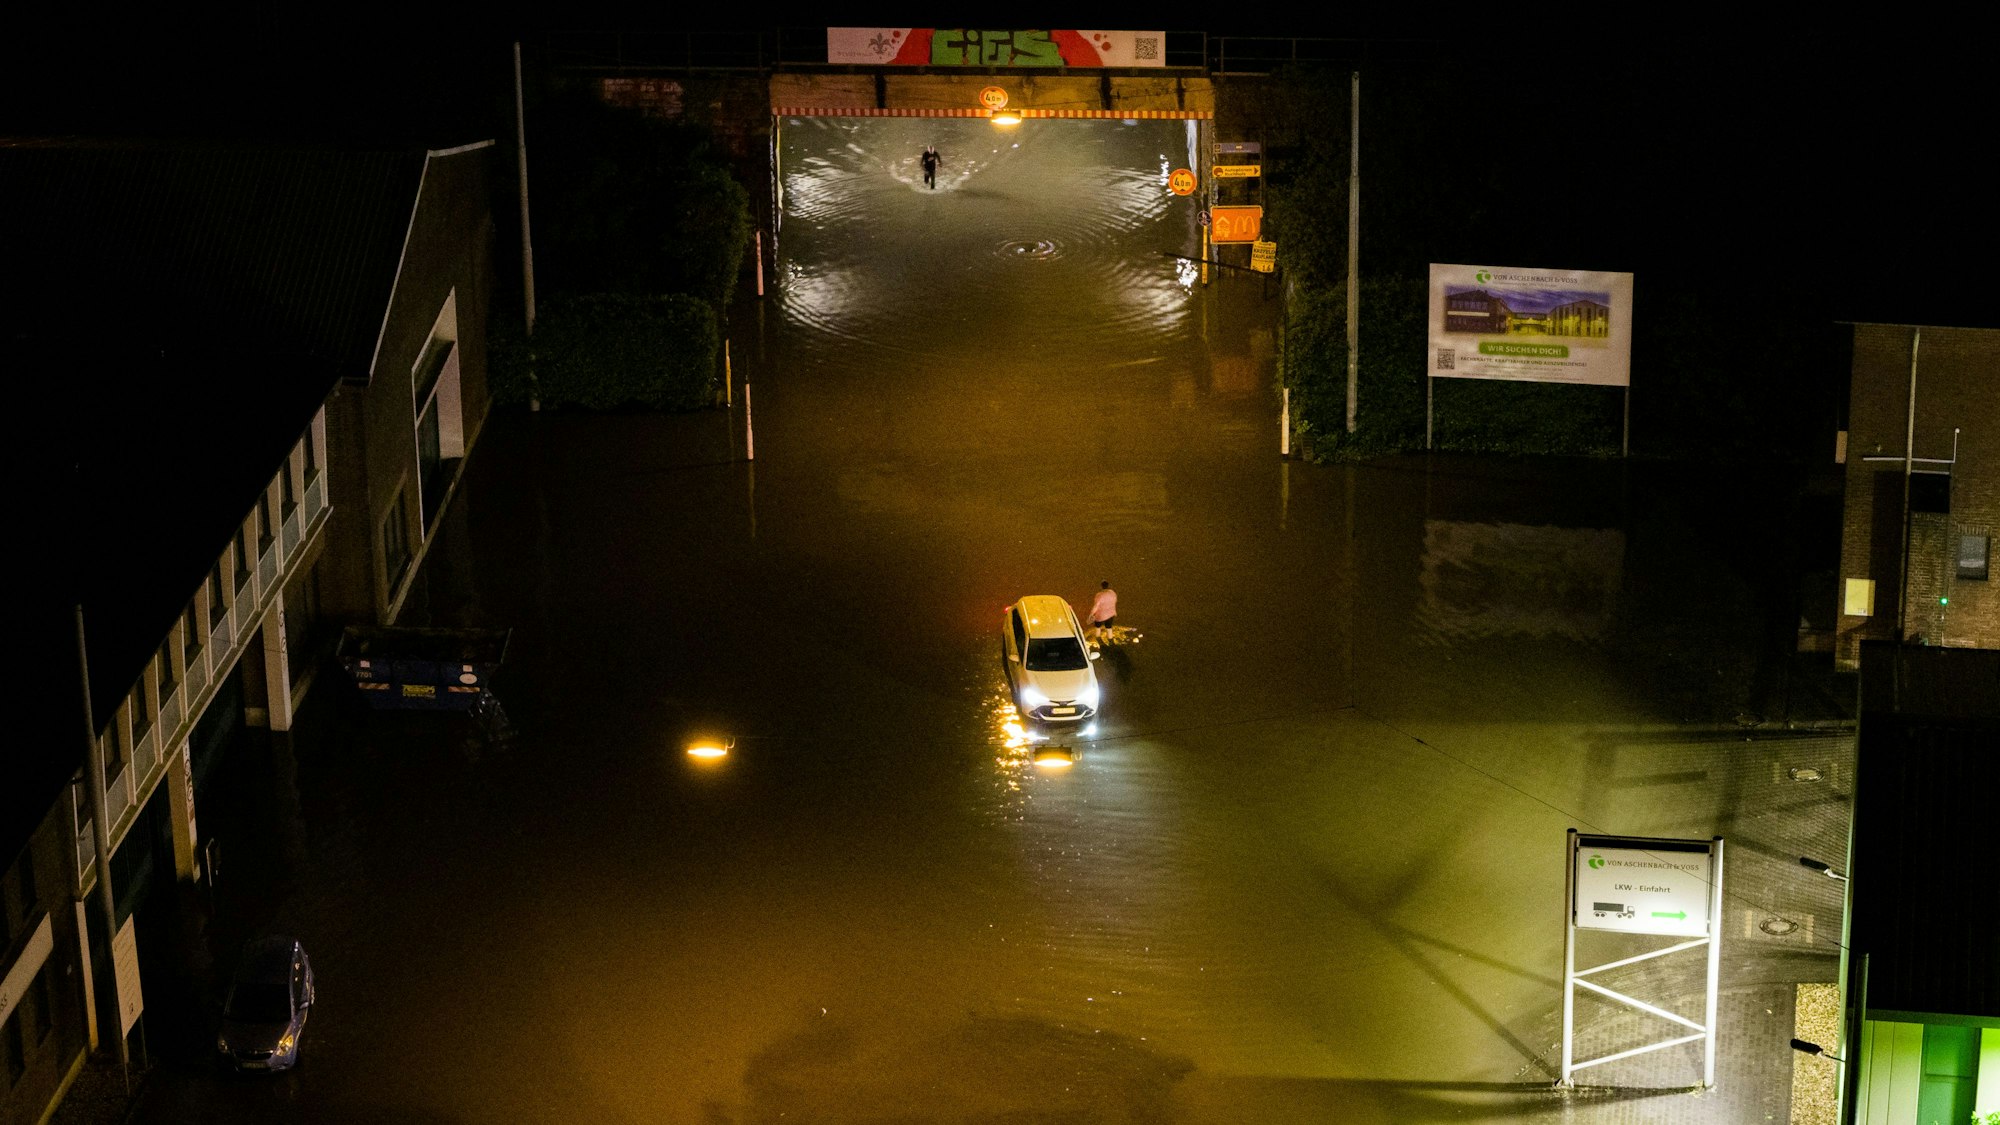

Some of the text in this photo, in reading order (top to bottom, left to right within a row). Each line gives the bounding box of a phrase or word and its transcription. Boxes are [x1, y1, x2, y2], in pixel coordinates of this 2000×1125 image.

[1508, 274, 1553, 283] ASCHENBACH
[1487, 345, 1562, 355] WIR SUCHEN DICH!
[1623, 861, 1673, 870] ASCHENBACH
[1614, 883, 1633, 891] LKW
[1639, 885, 1671, 893] Einfahrt
